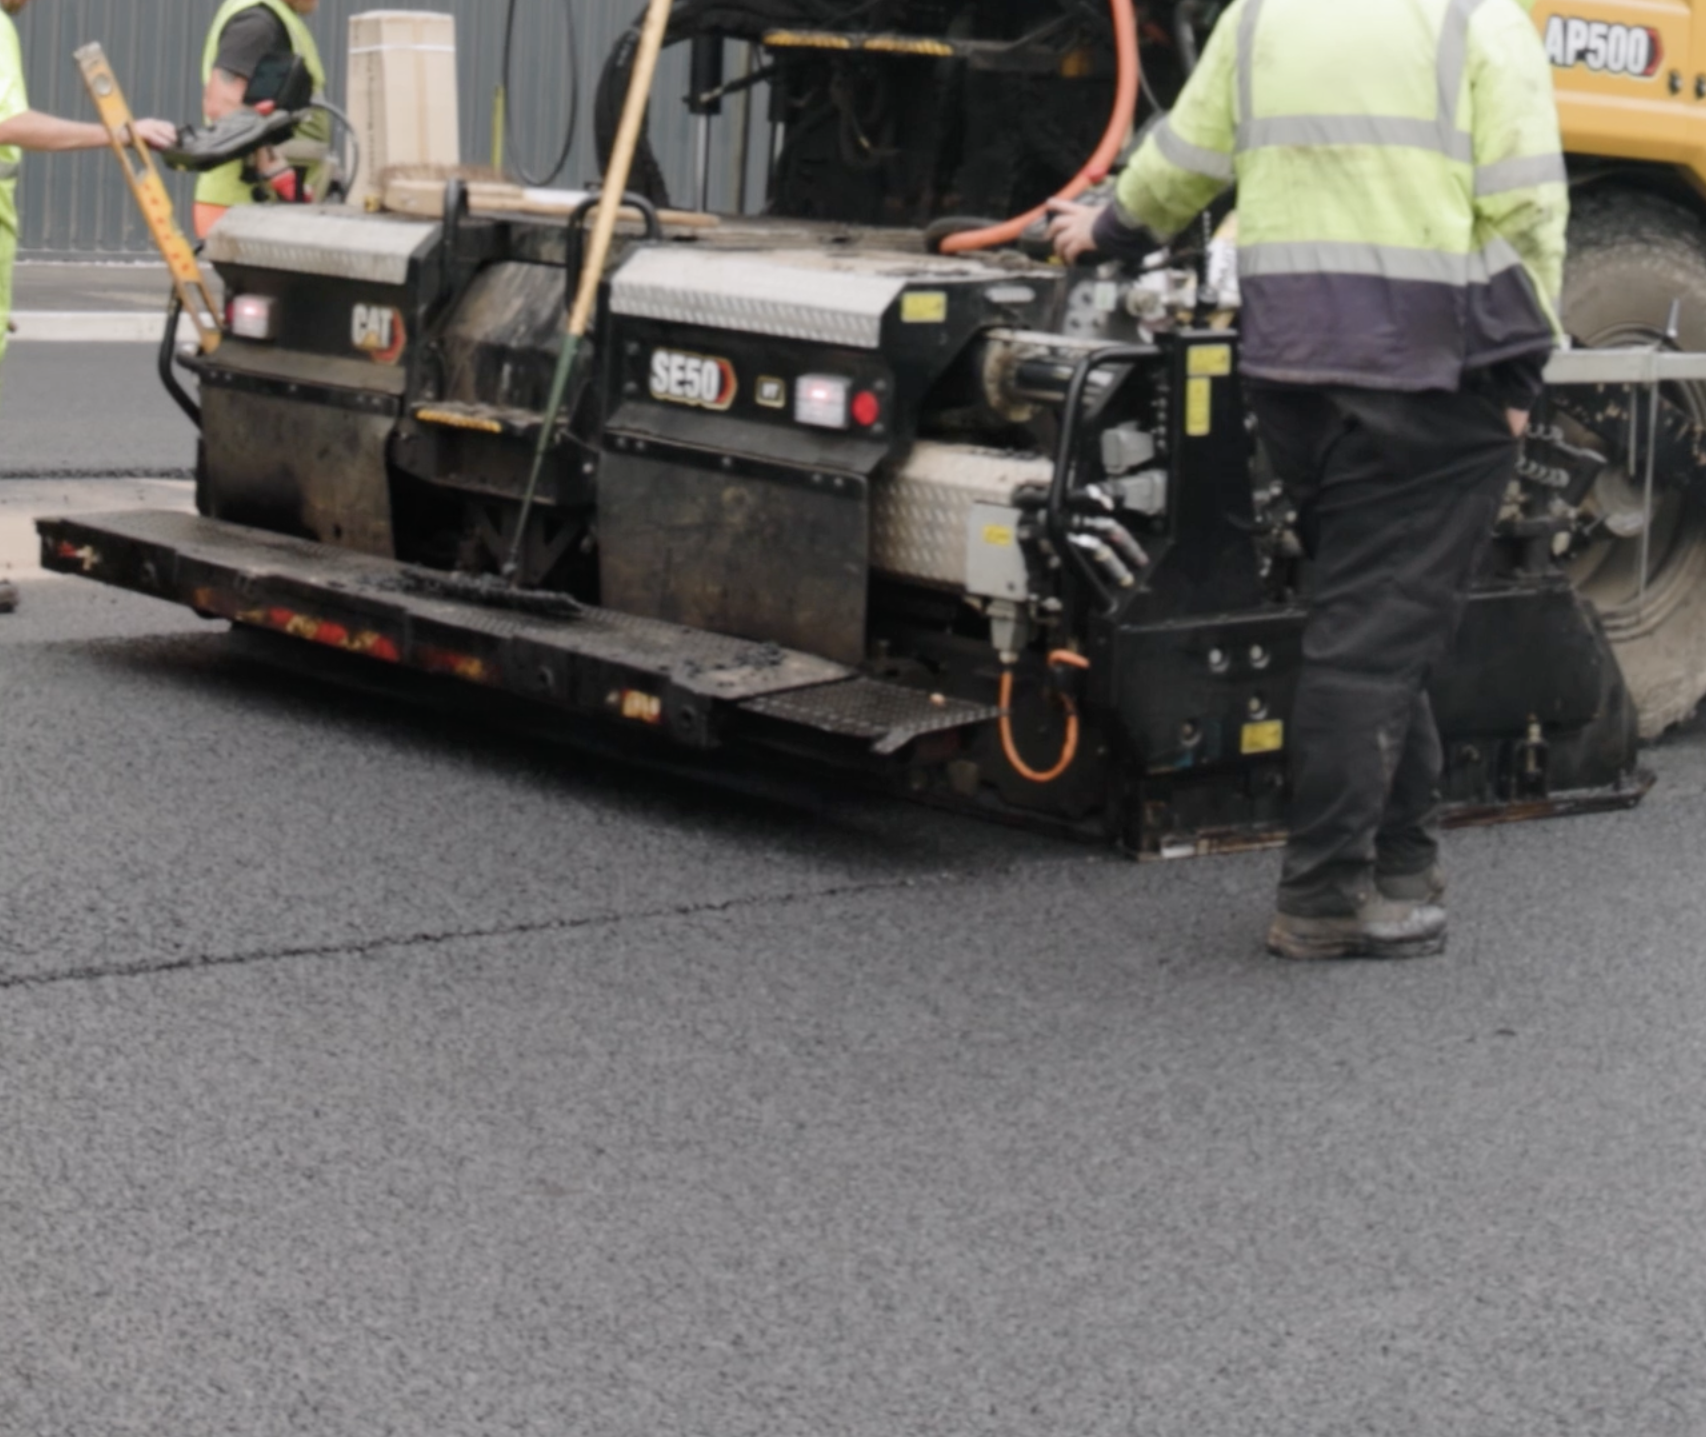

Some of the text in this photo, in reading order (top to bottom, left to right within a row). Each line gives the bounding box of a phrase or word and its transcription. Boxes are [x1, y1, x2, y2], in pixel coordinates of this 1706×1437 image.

[1545, 14, 1651, 77] AP500
[352, 303, 393, 350] CAT
[650, 349, 721, 404] SE50
